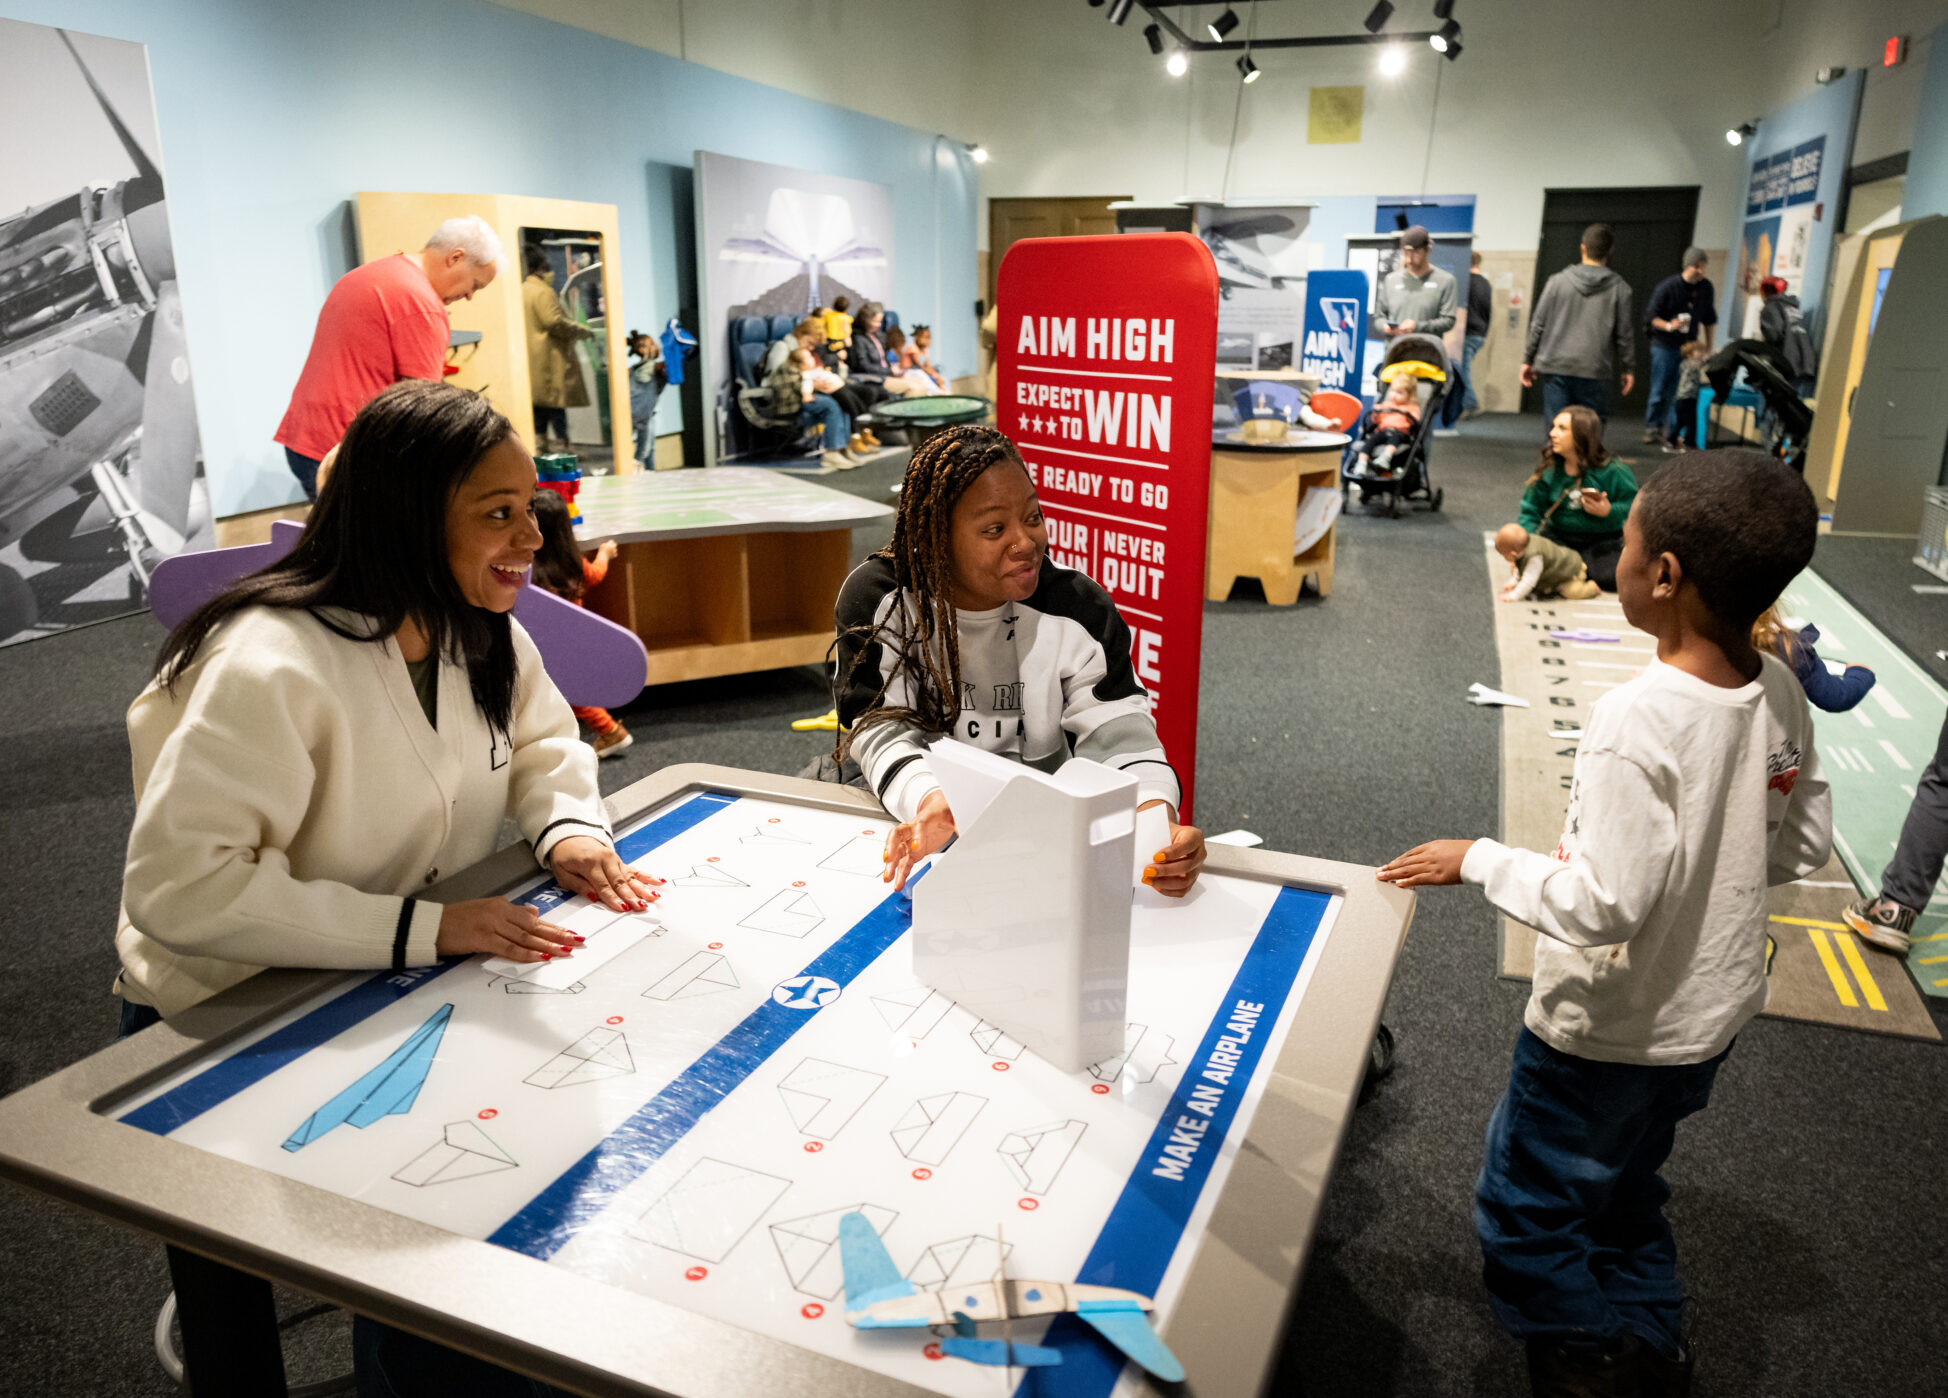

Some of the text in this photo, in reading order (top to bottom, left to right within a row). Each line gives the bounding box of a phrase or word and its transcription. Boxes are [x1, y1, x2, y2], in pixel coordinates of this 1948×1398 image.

[1017, 315, 1175, 363] AIM HIGH
[1304, 330, 1338, 358] AIM
[1303, 357, 1346, 388] HIGH
[1017, 382, 1083, 411] EXPECT
[1060, 415, 1083, 441] TO
[1084, 389, 1172, 453] WIN
[1024, 462, 1169, 510] E READY TO GO
[1045, 517, 1088, 554] OUR
[1103, 530, 1166, 565] NEVER
[1103, 557, 1165, 600] QUIT
[1152, 999, 1265, 1182] MAKE AN AIRPLANE
